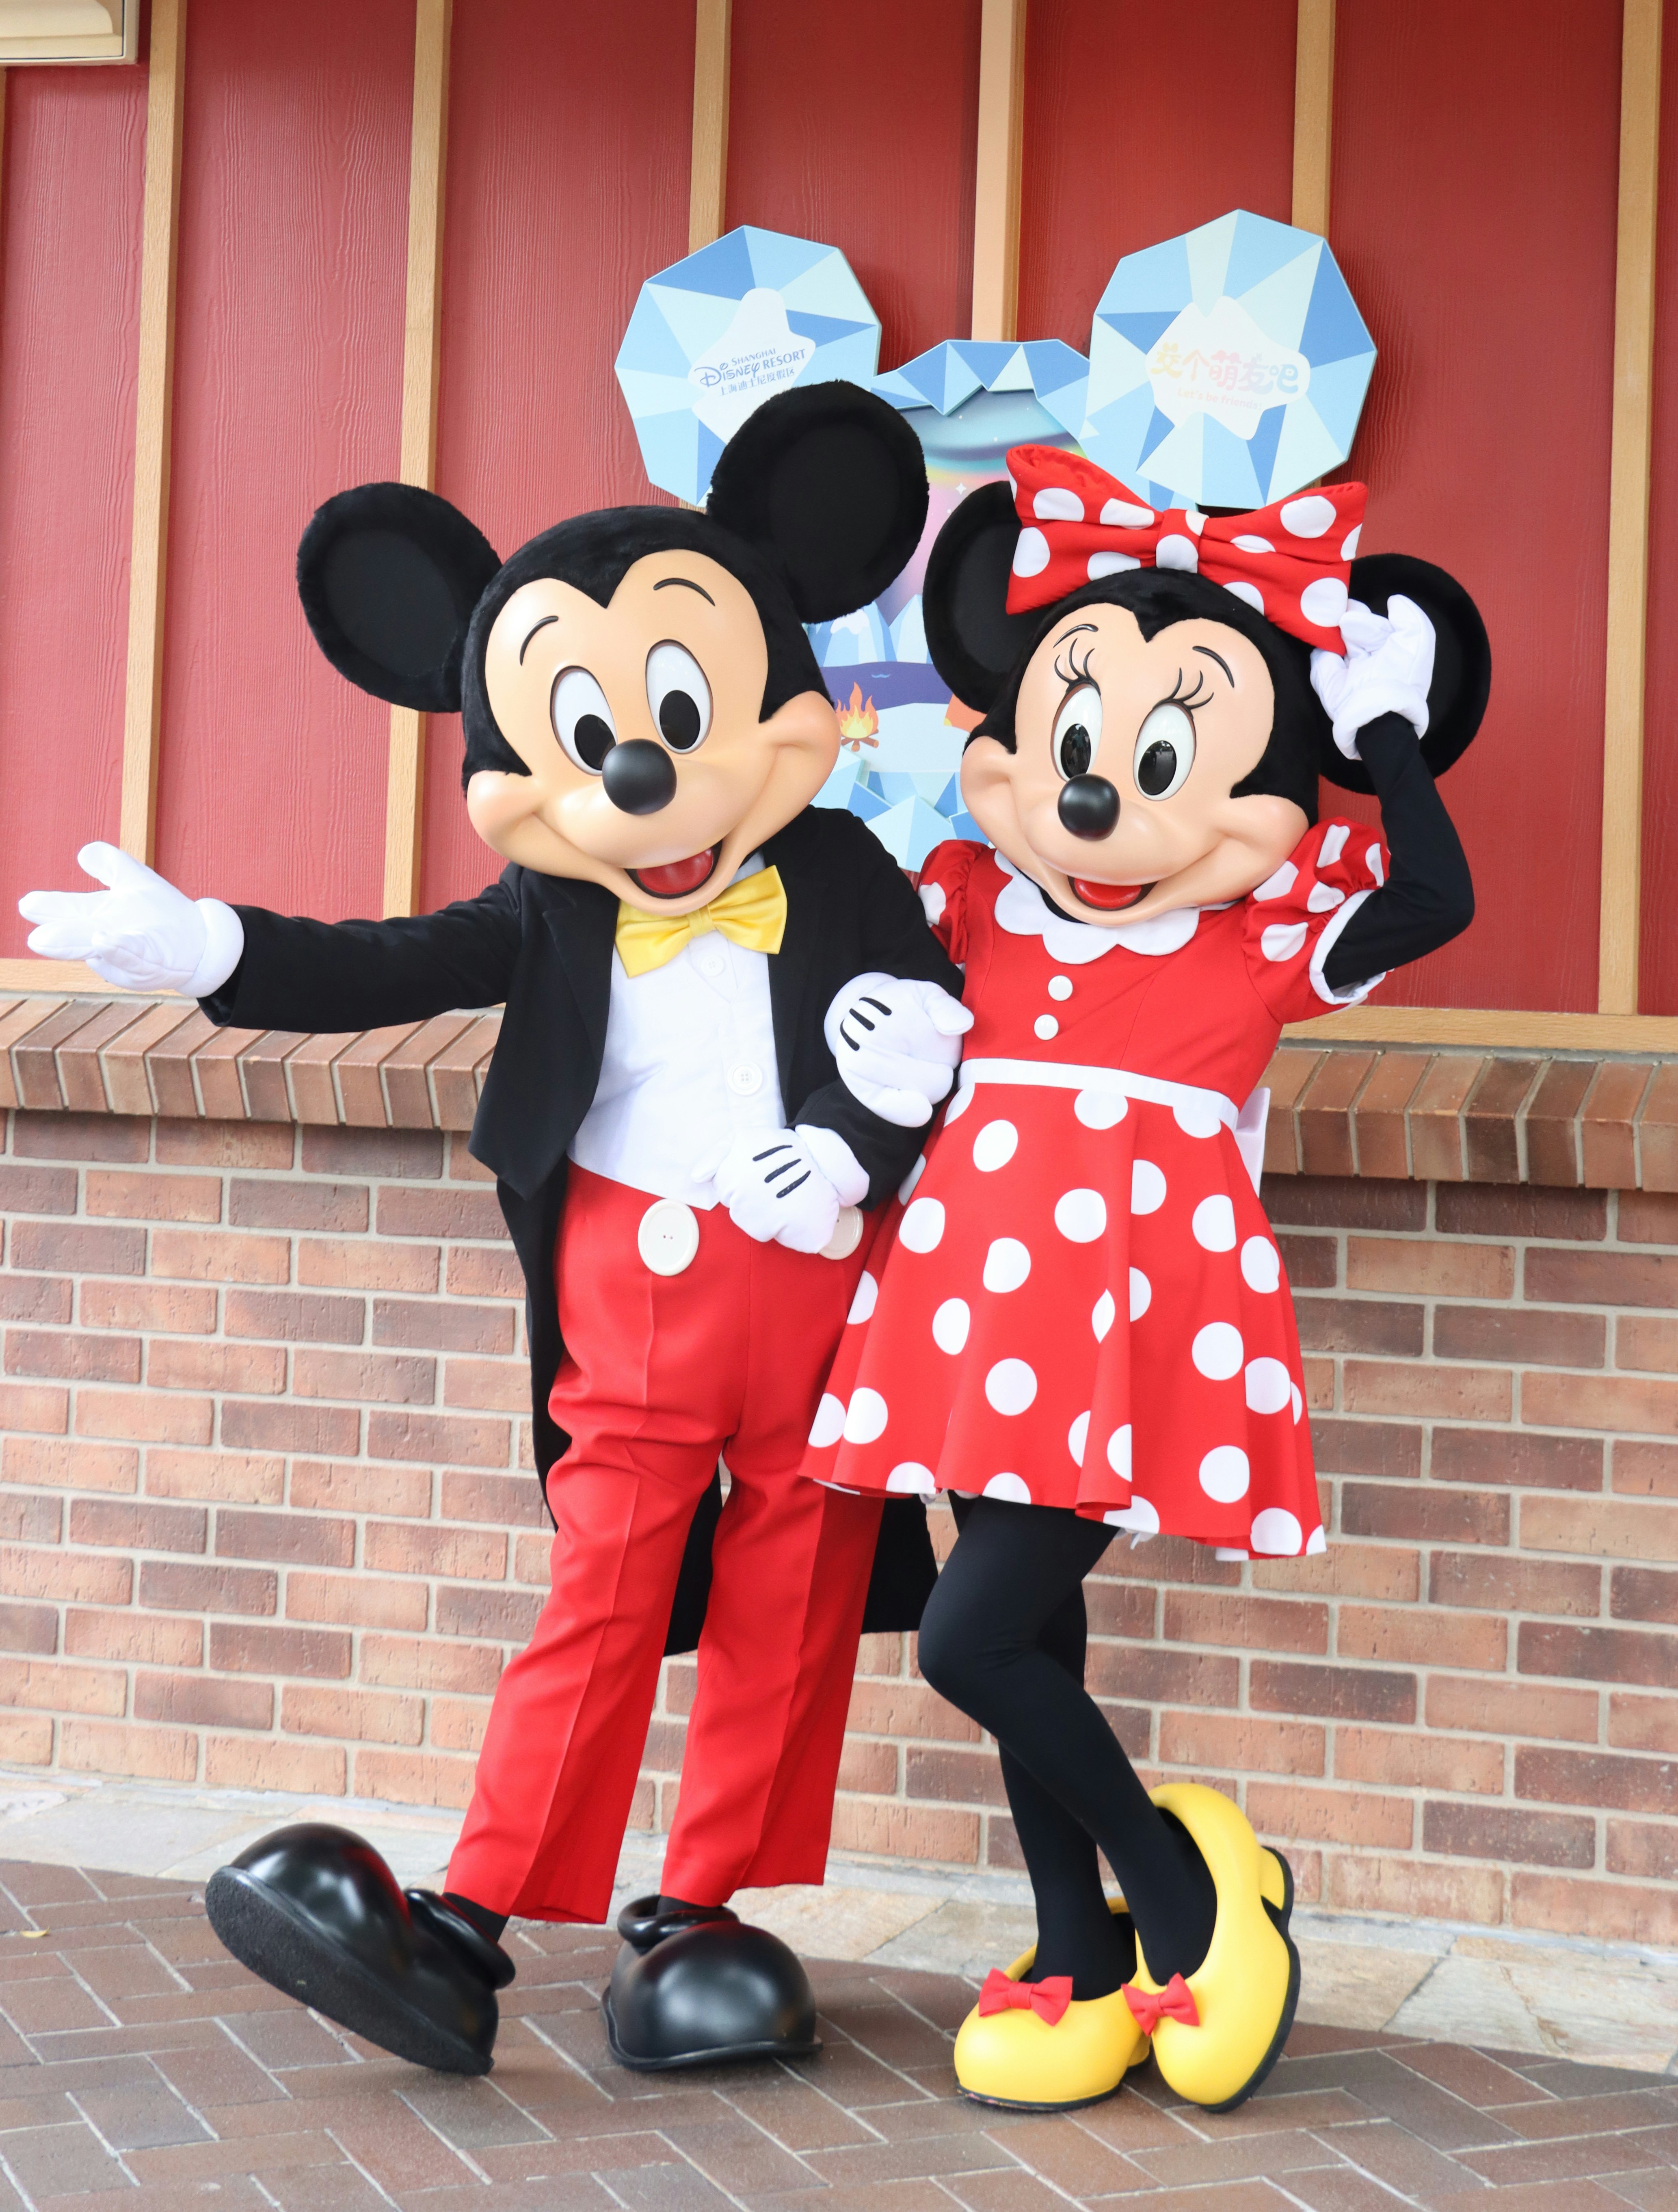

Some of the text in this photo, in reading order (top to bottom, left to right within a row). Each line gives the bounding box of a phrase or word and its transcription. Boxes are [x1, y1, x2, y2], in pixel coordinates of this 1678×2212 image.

[763, 348, 806, 370] RESORT
[1150, 342, 1299, 394] 交个萌友吧
[720, 366, 795, 397] 上海迪士尼度假区
[1178, 387, 1262, 411] Let's be friends!
